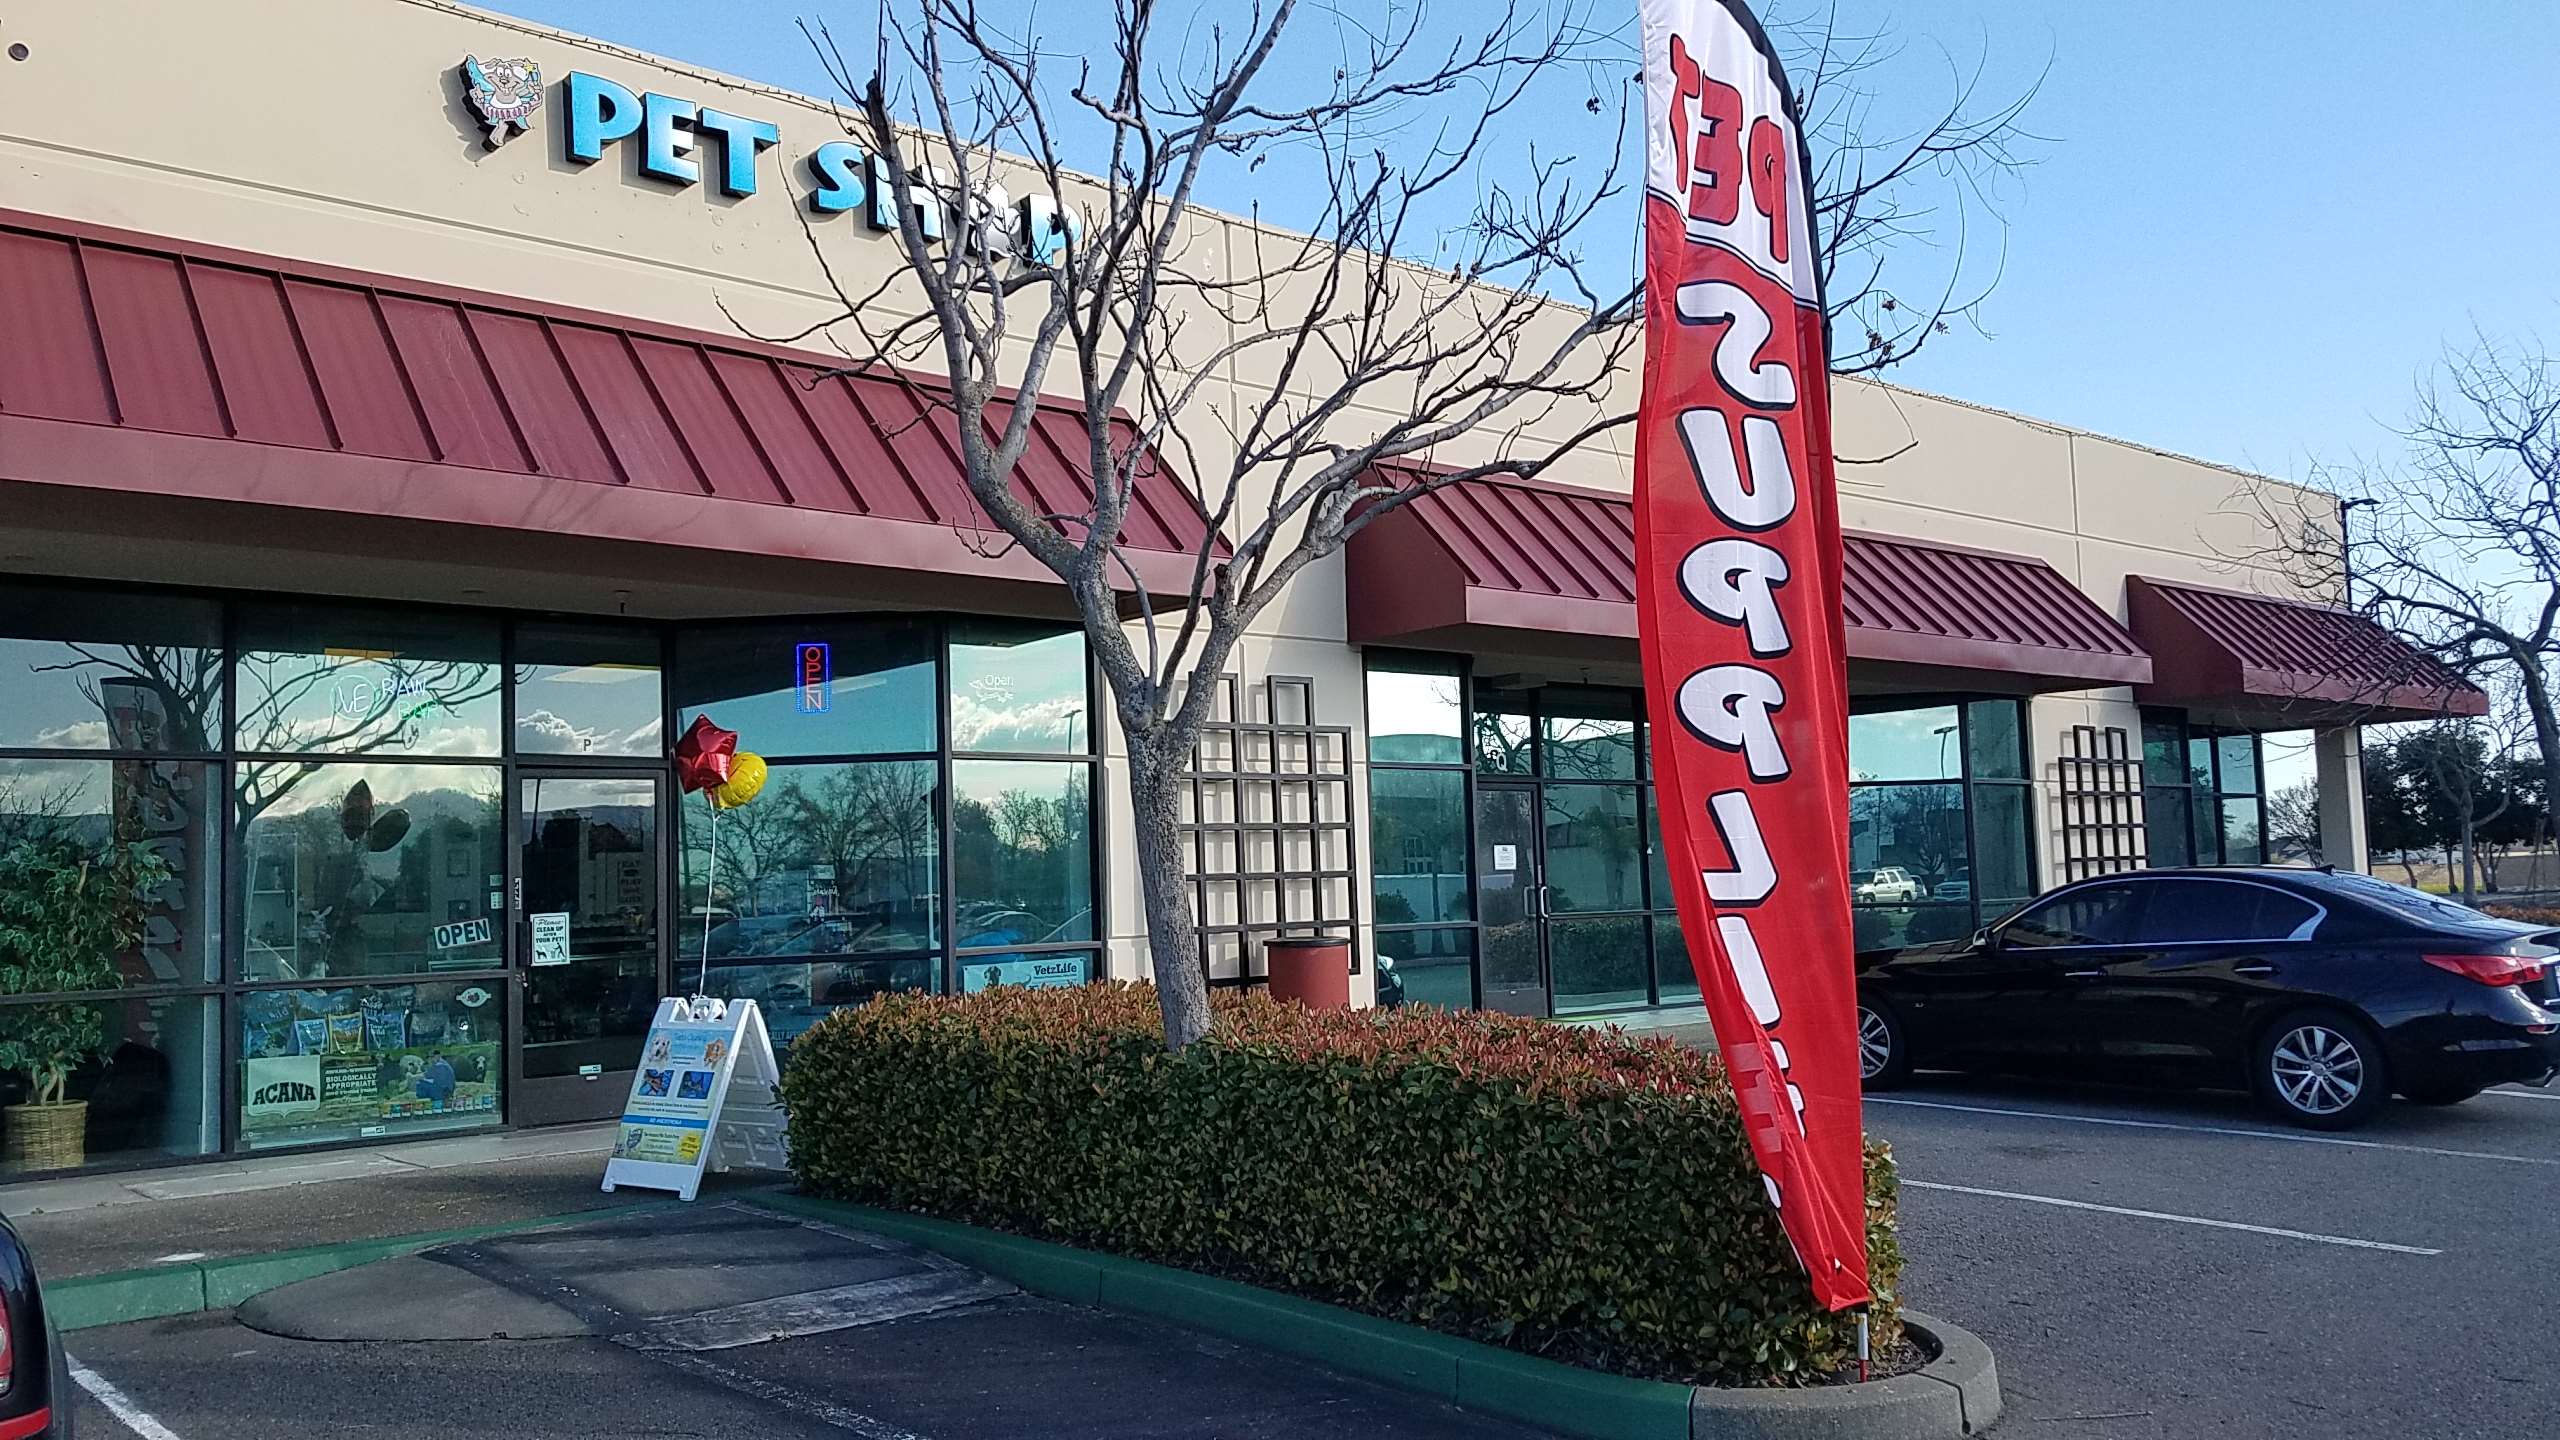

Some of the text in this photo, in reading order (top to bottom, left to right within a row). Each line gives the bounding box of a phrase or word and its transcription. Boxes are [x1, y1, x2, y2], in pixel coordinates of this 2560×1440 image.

[565, 71, 778, 198] PET
[804, 646, 822, 710] OPEN
[984, 674, 1014, 688] Open
[583, 738, 592, 752] P
[1496, 752, 1508, 772] Q
[437, 919, 490, 947] OPEN
[1033, 963, 1078, 975] VetzLife
[325, 1073, 377, 1083] BIOLOGICALLY
[325, 1080, 377, 1090] APPROPRIATE
[252, 1081, 317, 1106] ACANA
